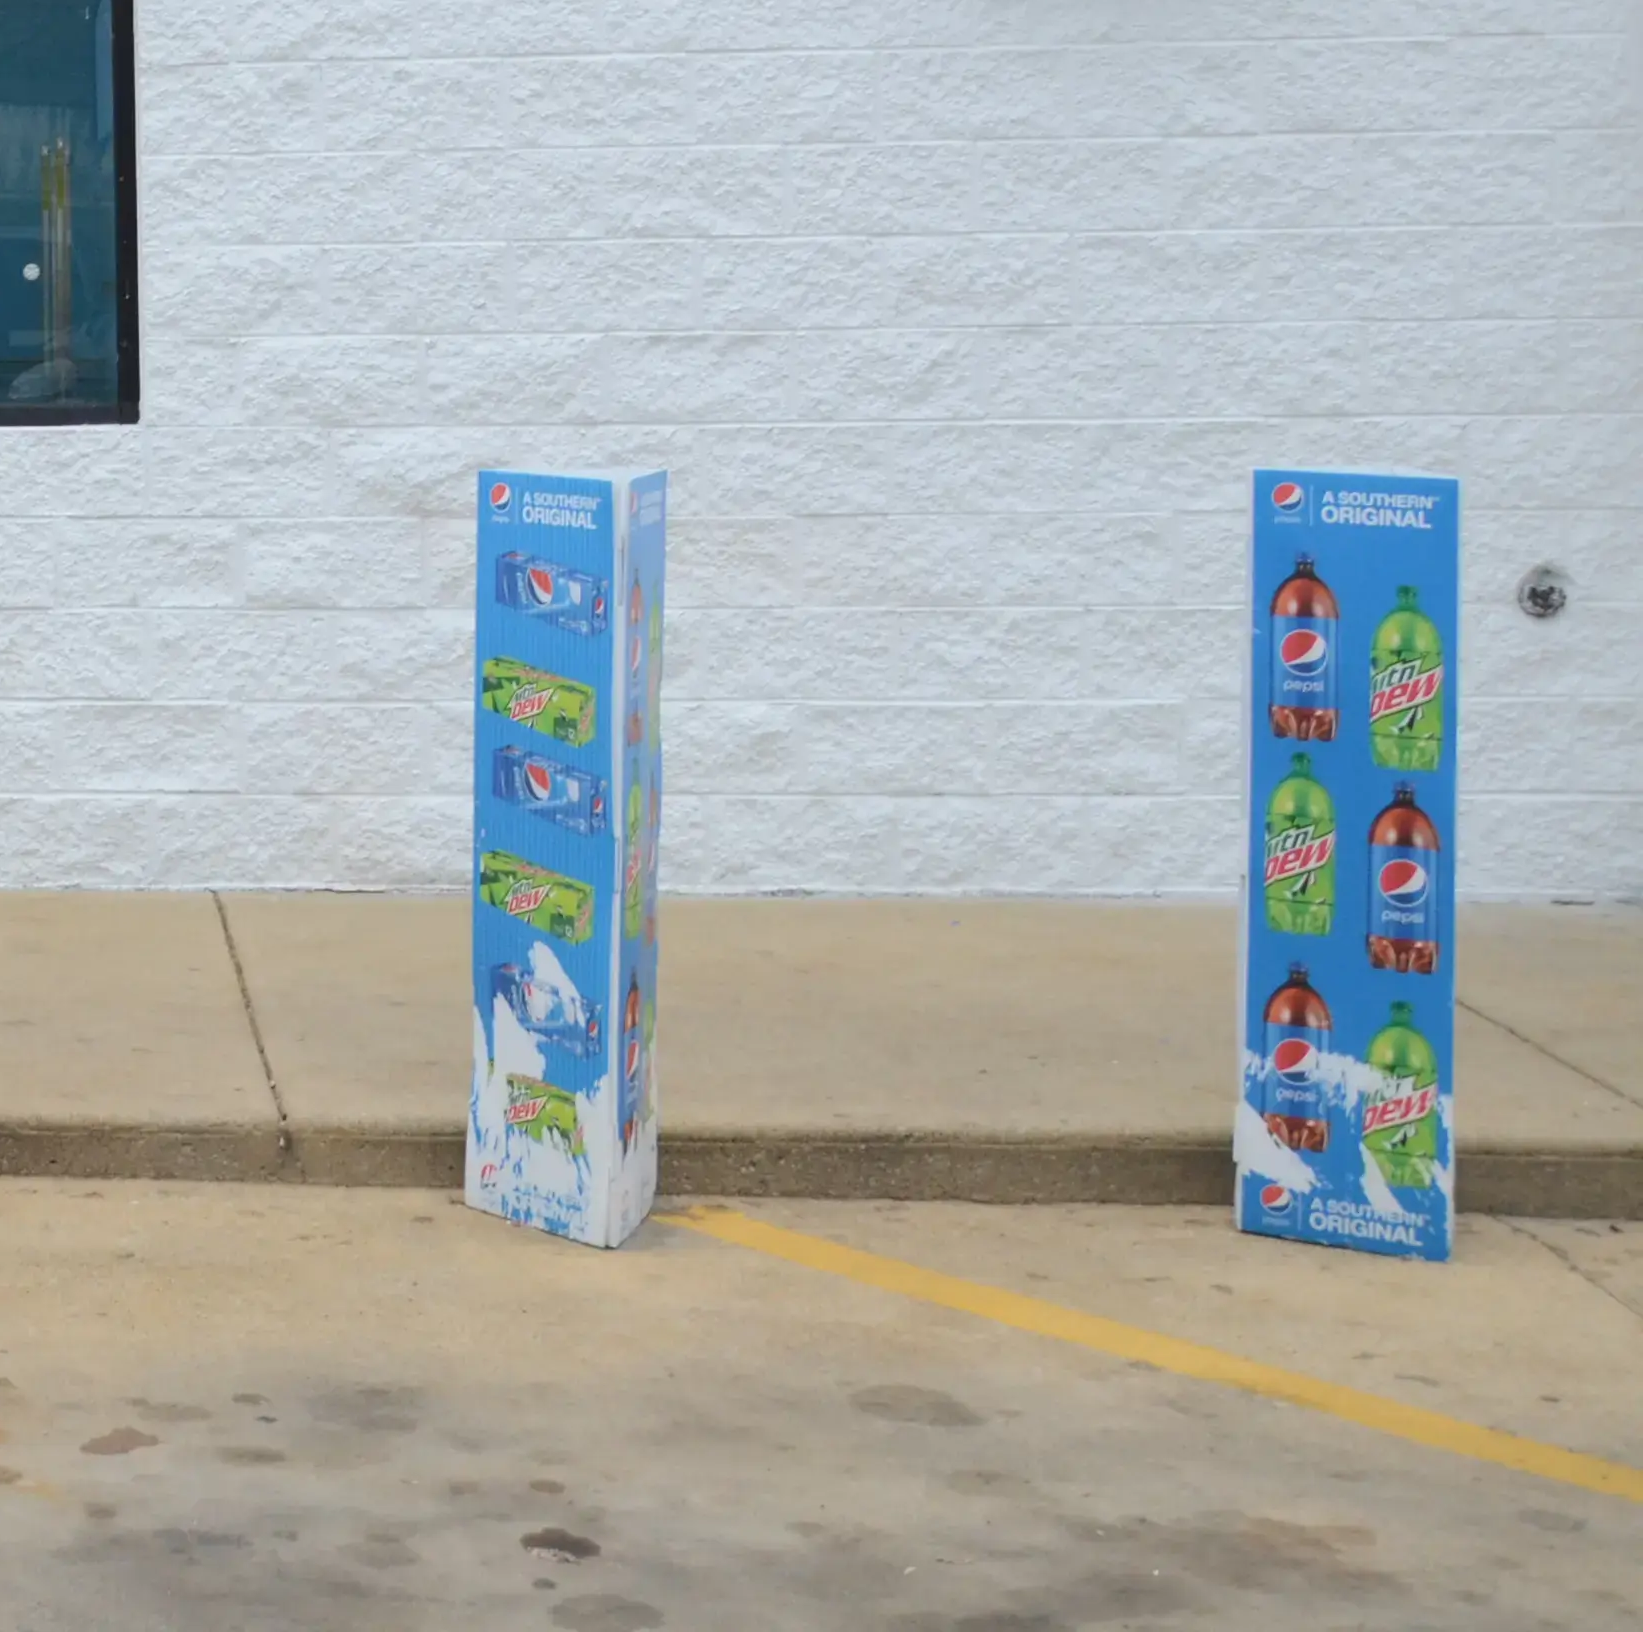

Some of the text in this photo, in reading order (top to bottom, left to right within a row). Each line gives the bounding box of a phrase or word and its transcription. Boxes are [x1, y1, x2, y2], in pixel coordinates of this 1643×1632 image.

[523, 490, 598, 510] A SOUTHERN
[1322, 490, 1434, 510] A SOUTHERN
[522, 506, 599, 530] ORIGINAL
[1321, 506, 1434, 530] ORIGINAL
[1310, 1196, 1322, 1211] A
[1309, 1212, 1424, 1247] ORIGINAL
